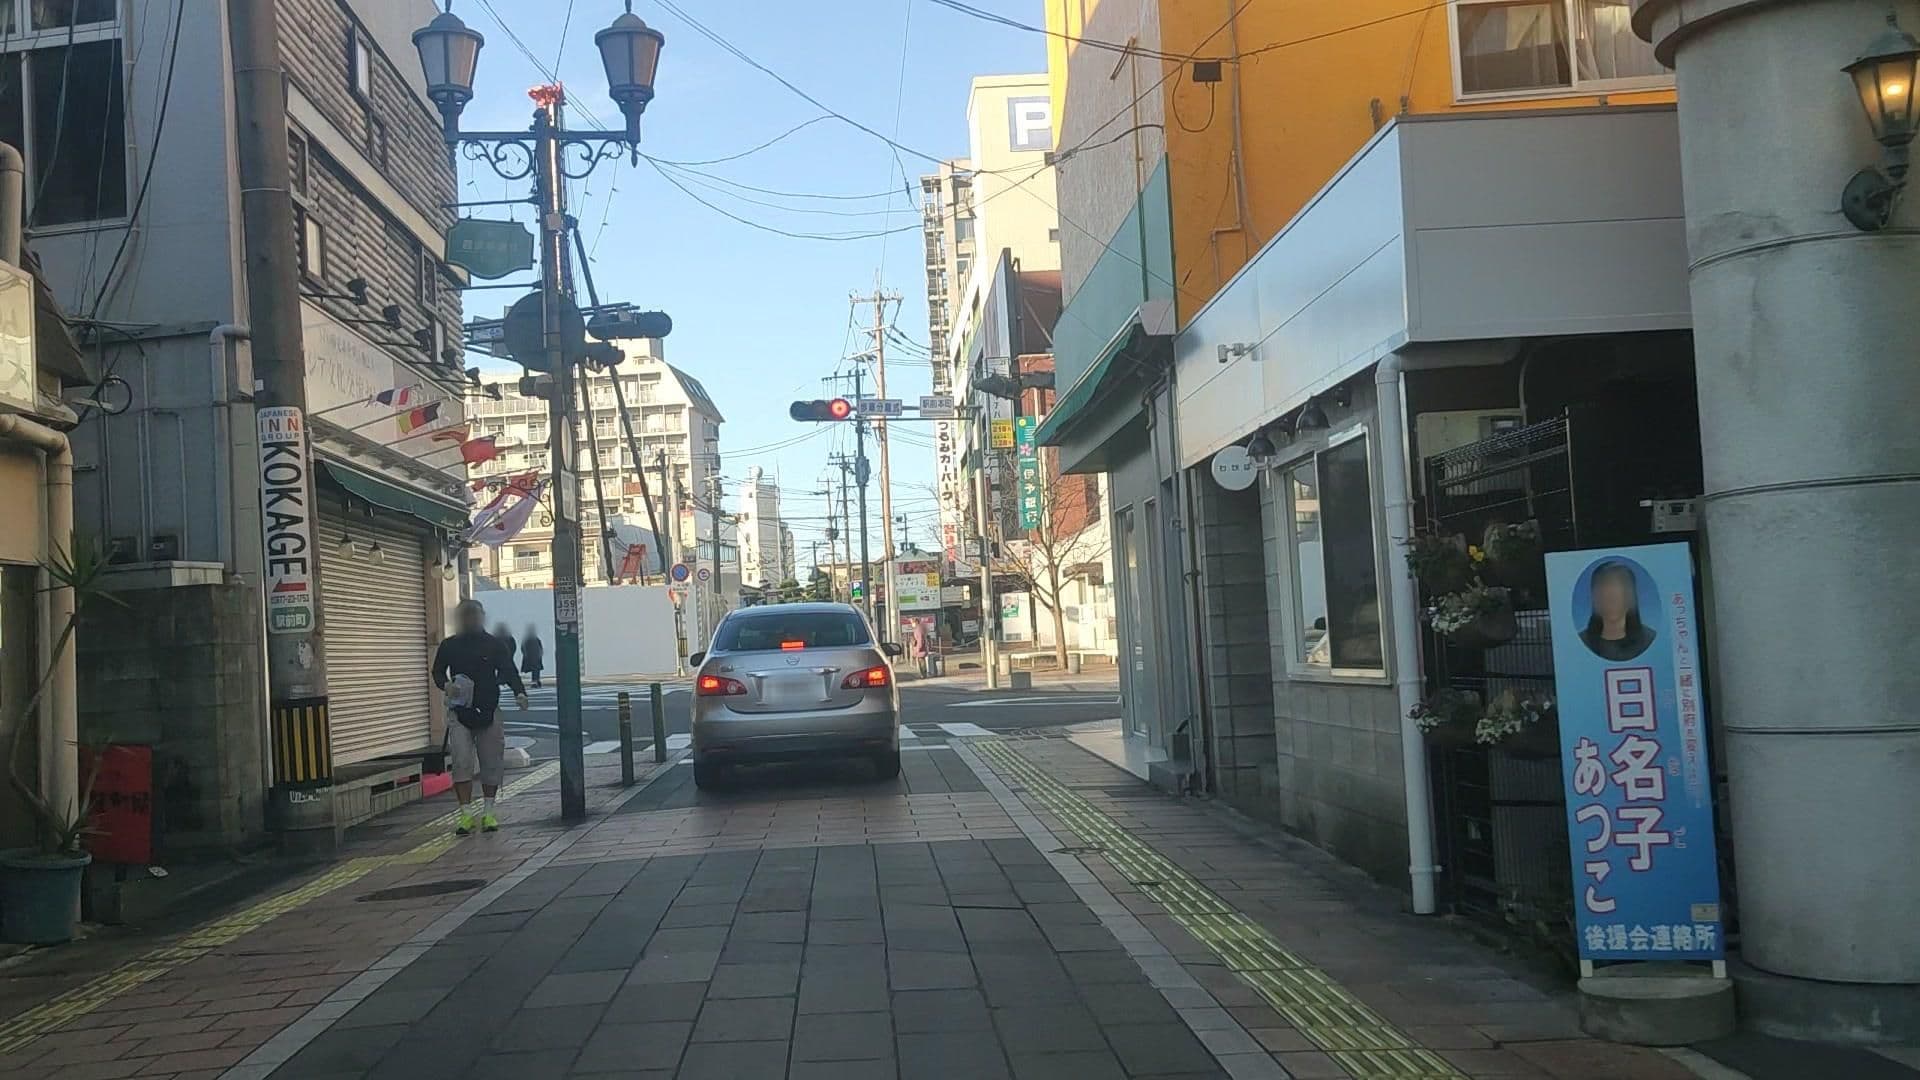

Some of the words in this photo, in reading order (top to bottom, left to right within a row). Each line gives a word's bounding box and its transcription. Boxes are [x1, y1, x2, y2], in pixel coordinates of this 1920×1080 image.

[1015, 102, 1052, 145] P
[259, 409, 298, 419] JAPANESE
[860, 402, 900, 413] 歩車分離式
[922, 399, 952, 409] 駅前本町
[260, 417, 299, 433] INN
[261, 432, 300, 441] GROUP
[938, 421, 953, 500] つるみカーパーク
[262, 441, 307, 578] KOKAGE
[1023, 468, 1038, 523] 伊予銀行
[1604, 667, 1671, 872] 日名子
[1573, 736, 1616, 913] あつこ
[1584, 924, 1716, 953] 後援会連絡所
